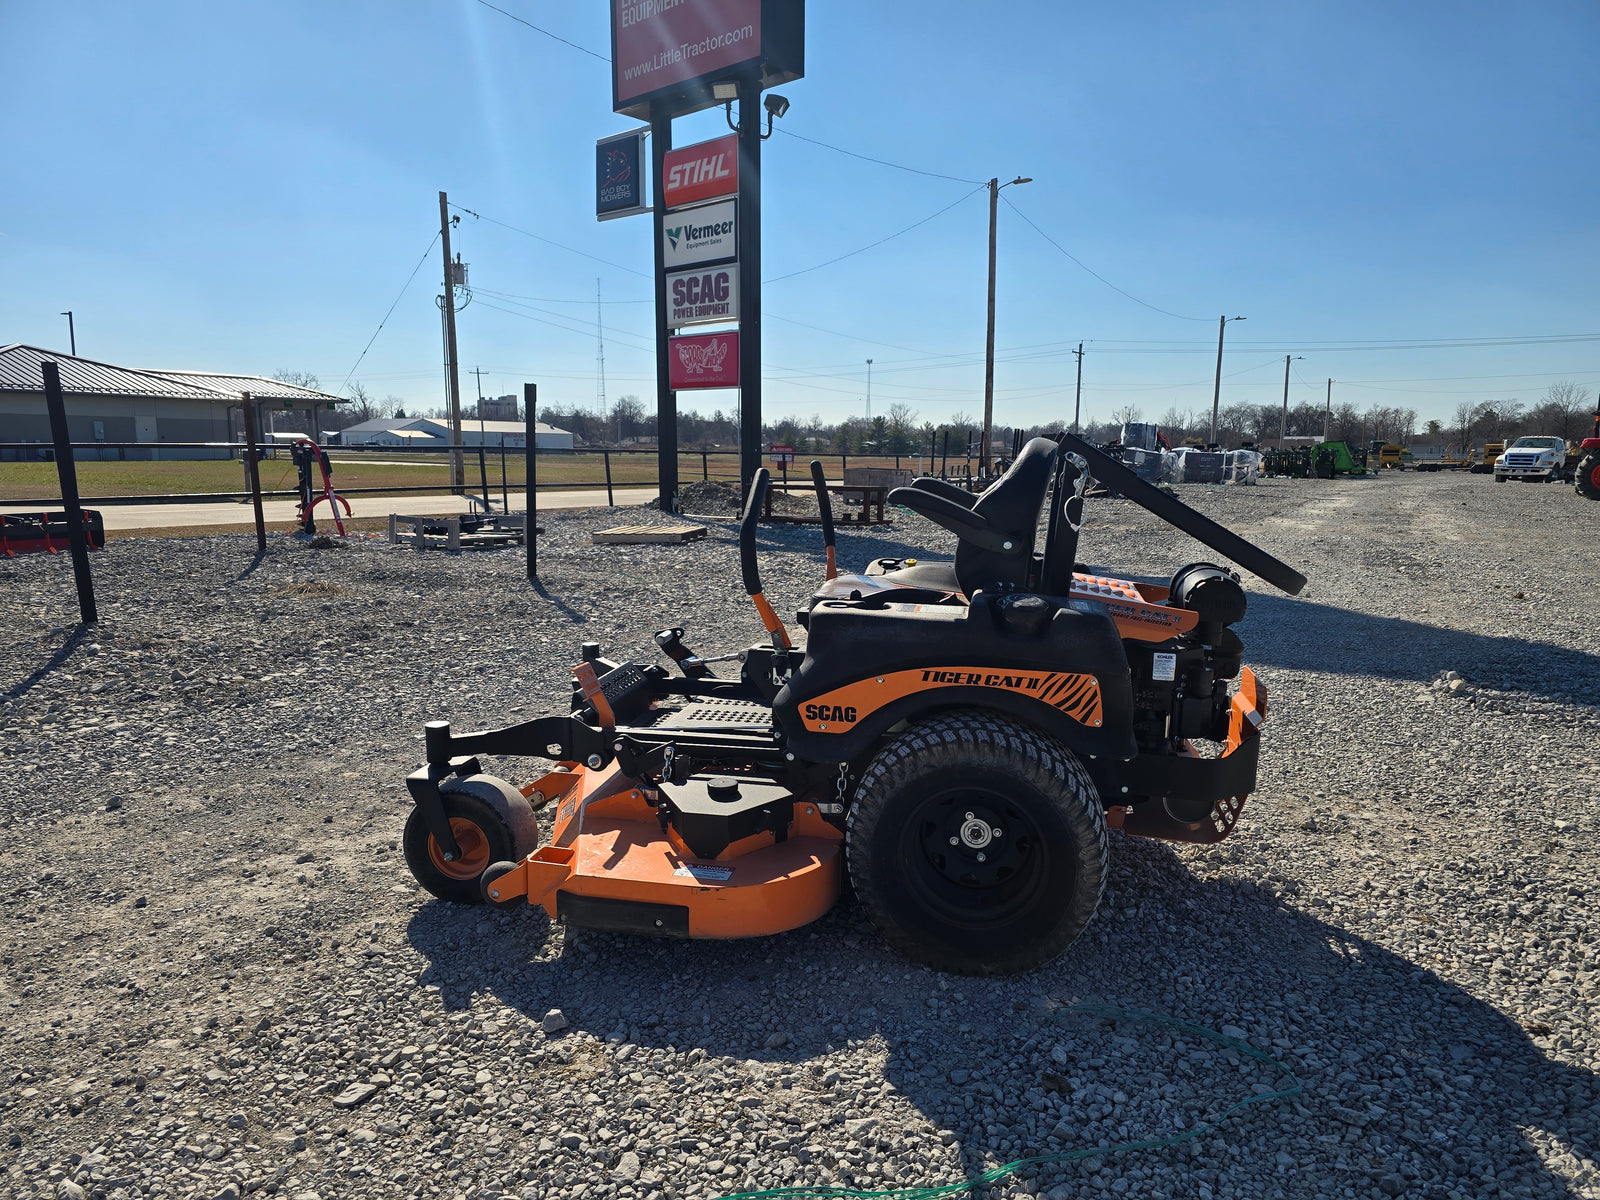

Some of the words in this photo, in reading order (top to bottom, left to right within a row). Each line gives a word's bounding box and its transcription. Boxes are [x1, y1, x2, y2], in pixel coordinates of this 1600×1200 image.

[622, 0, 685, 28] EQUIPMEN
[624, 24, 753, 80] www.LittleTractor.com
[667, 153, 730, 190] STIHL
[600, 186, 615, 196] BAD
[616, 184, 631, 192] BOY
[601, 190, 631, 202] MOWERS
[684, 220, 734, 241] Vermeer
[686, 240, 709, 250] Equipment
[710, 238, 722, 246] Sales
[672, 272, 729, 307] SCAG
[673, 306, 694, 319] POWER
[695, 302, 729, 317] EQUIPMENT
[920, 669, 980, 686] TIGER
[984, 674, 1028, 689] CAT
[1028, 677, 1041, 690] II
[805, 704, 857, 723] SCAG
